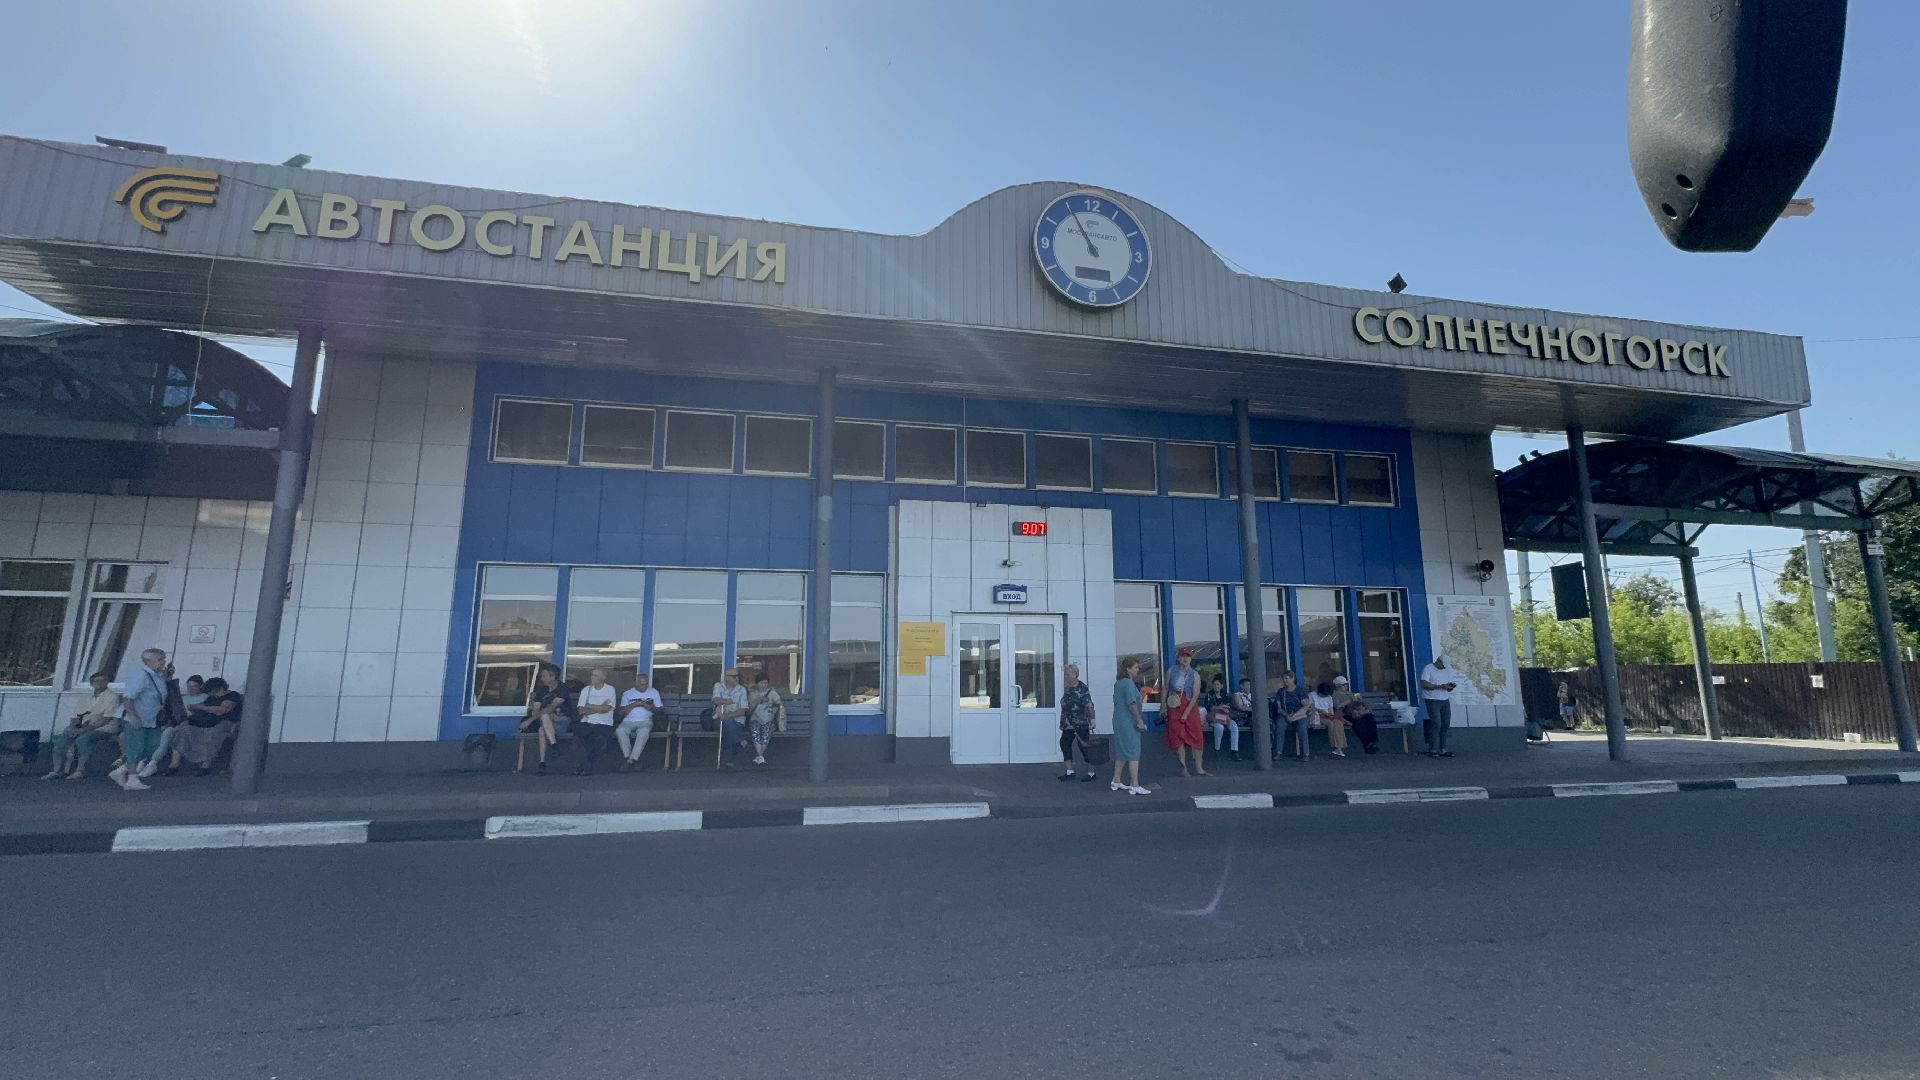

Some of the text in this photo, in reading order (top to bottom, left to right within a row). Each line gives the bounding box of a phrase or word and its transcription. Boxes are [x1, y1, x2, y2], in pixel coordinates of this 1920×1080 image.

[1084, 199, 1101, 213] 12
[252, 187, 788, 285] АВТОСТАНЦИЯ
[1067, 228, 1117, 241] МОСРАНСАВТО
[1041, 236, 1050, 249] 9
[1135, 252, 1143, 263] 3
[1089, 291, 1097, 303] 6
[1354, 306, 1731, 378] СОЛНЕЧНОГОРСК
[1002, 593, 1022, 601] ВХОД
